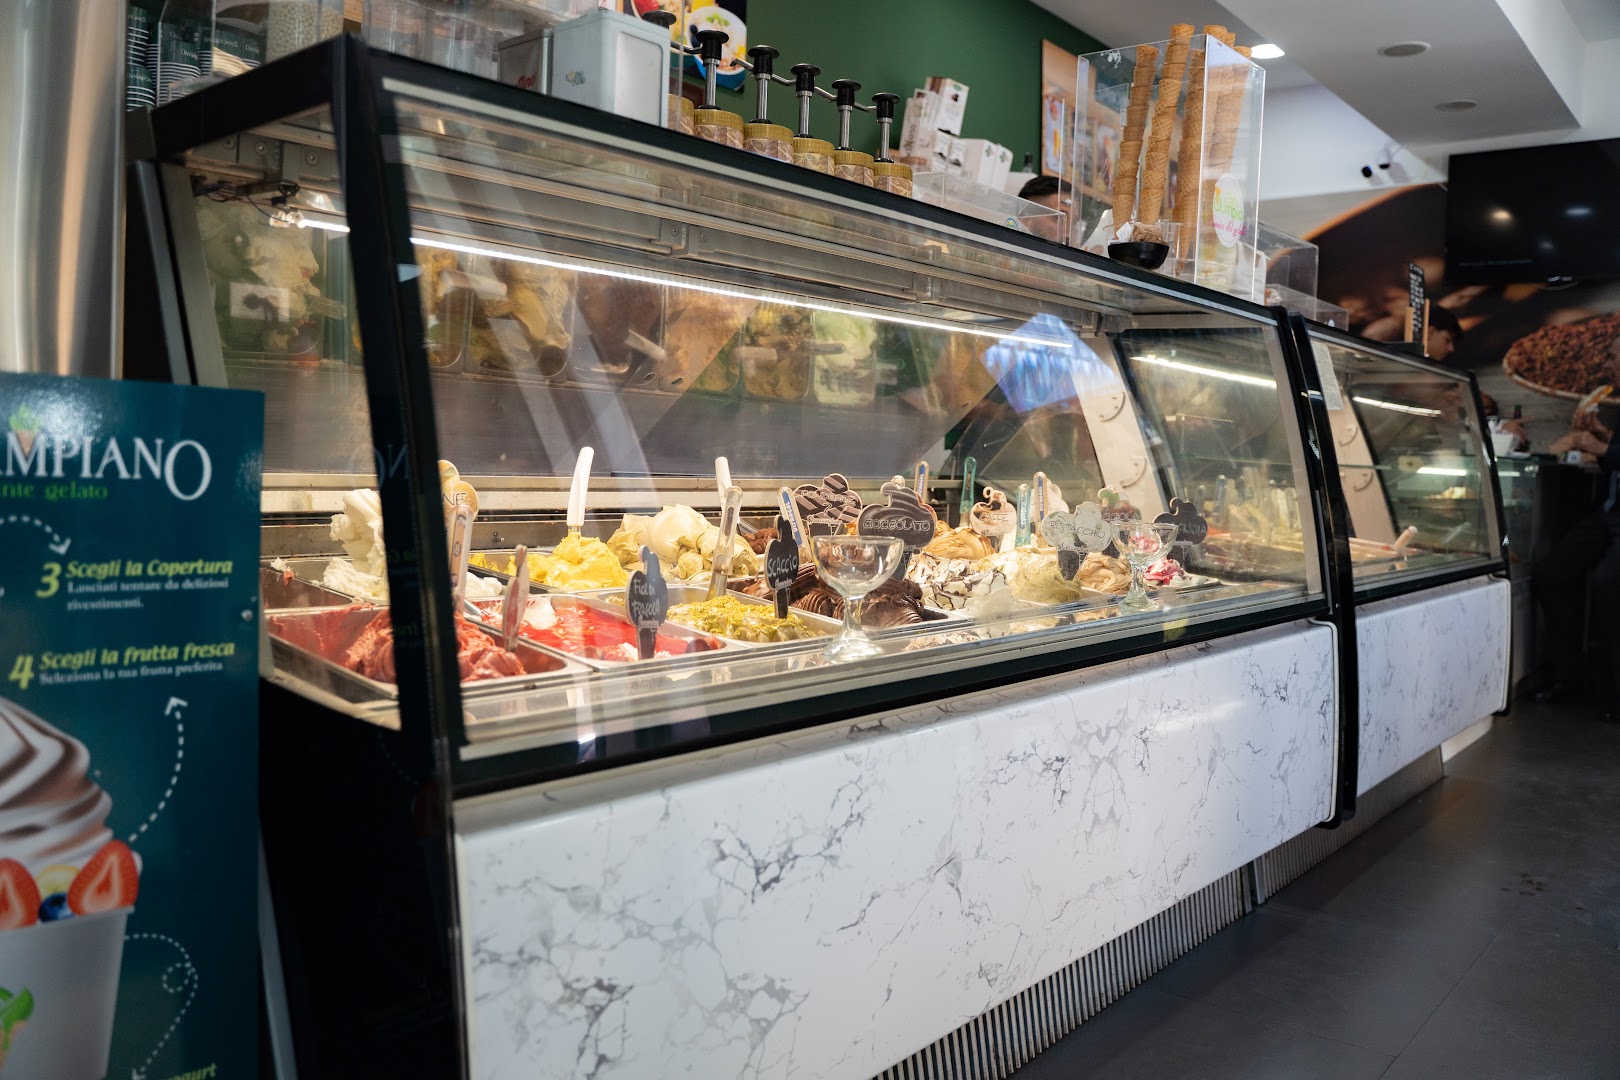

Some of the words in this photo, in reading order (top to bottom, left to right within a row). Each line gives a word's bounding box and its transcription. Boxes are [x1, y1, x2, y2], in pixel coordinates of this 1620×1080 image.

[0, 430, 212, 501] MPIANO
[45, 481, 108, 501] gelato
[1049, 519, 1106, 539] PISTACCHIO
[36, 561, 62, 599] 3
[65, 559, 121, 580] Scegli
[125, 560, 144, 577] la
[147, 559, 234, 579] Copertura
[8, 654, 35, 690] 4
[39, 649, 98, 669] Scegli
[101, 648, 119, 665] la
[123, 645, 179, 666] frutta
[183, 642, 236, 661] fresca
